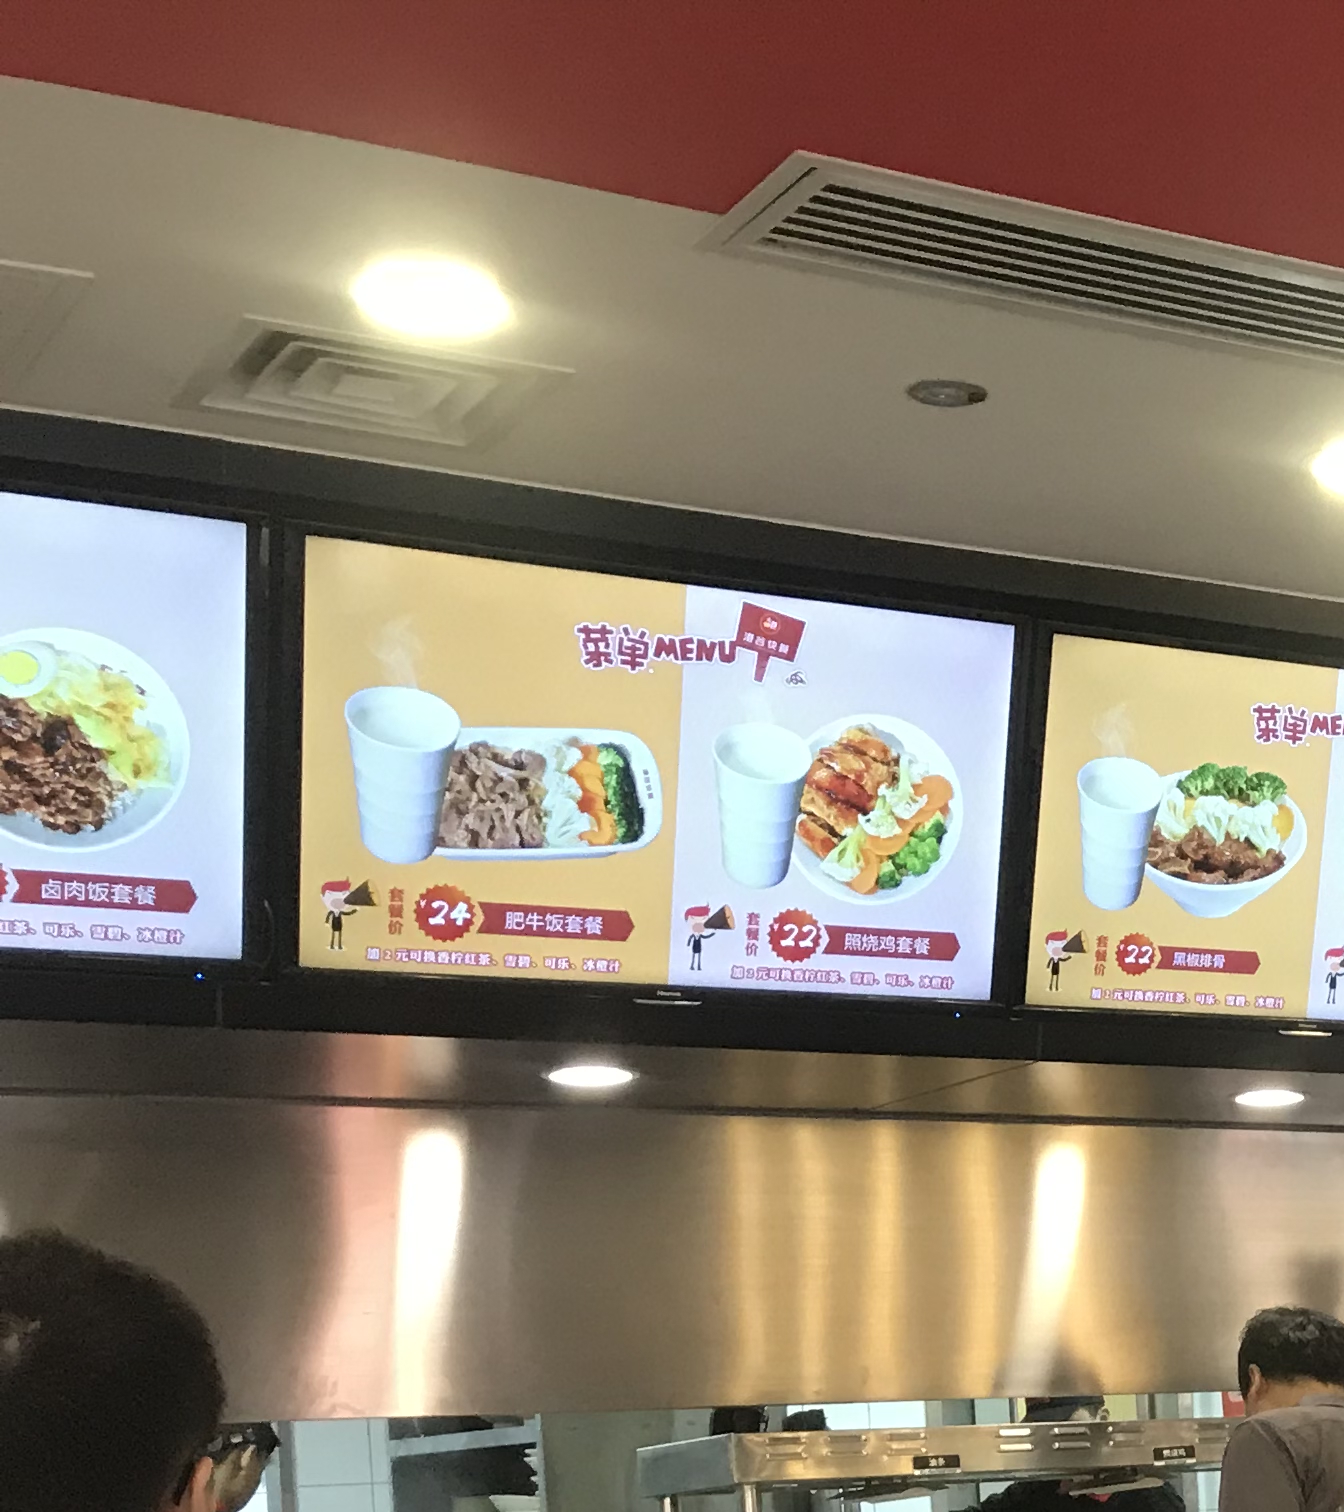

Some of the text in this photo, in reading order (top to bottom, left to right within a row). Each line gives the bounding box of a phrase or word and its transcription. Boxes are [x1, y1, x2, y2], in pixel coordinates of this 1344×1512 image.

[41, 879, 157, 906] 卤肉饭套餐
[504, 911, 604, 936] 肥牛饭套餐
[843, 932, 931, 956] 照烧鸡套餐
[1171, 951, 1226, 969] 黑椒排骨
